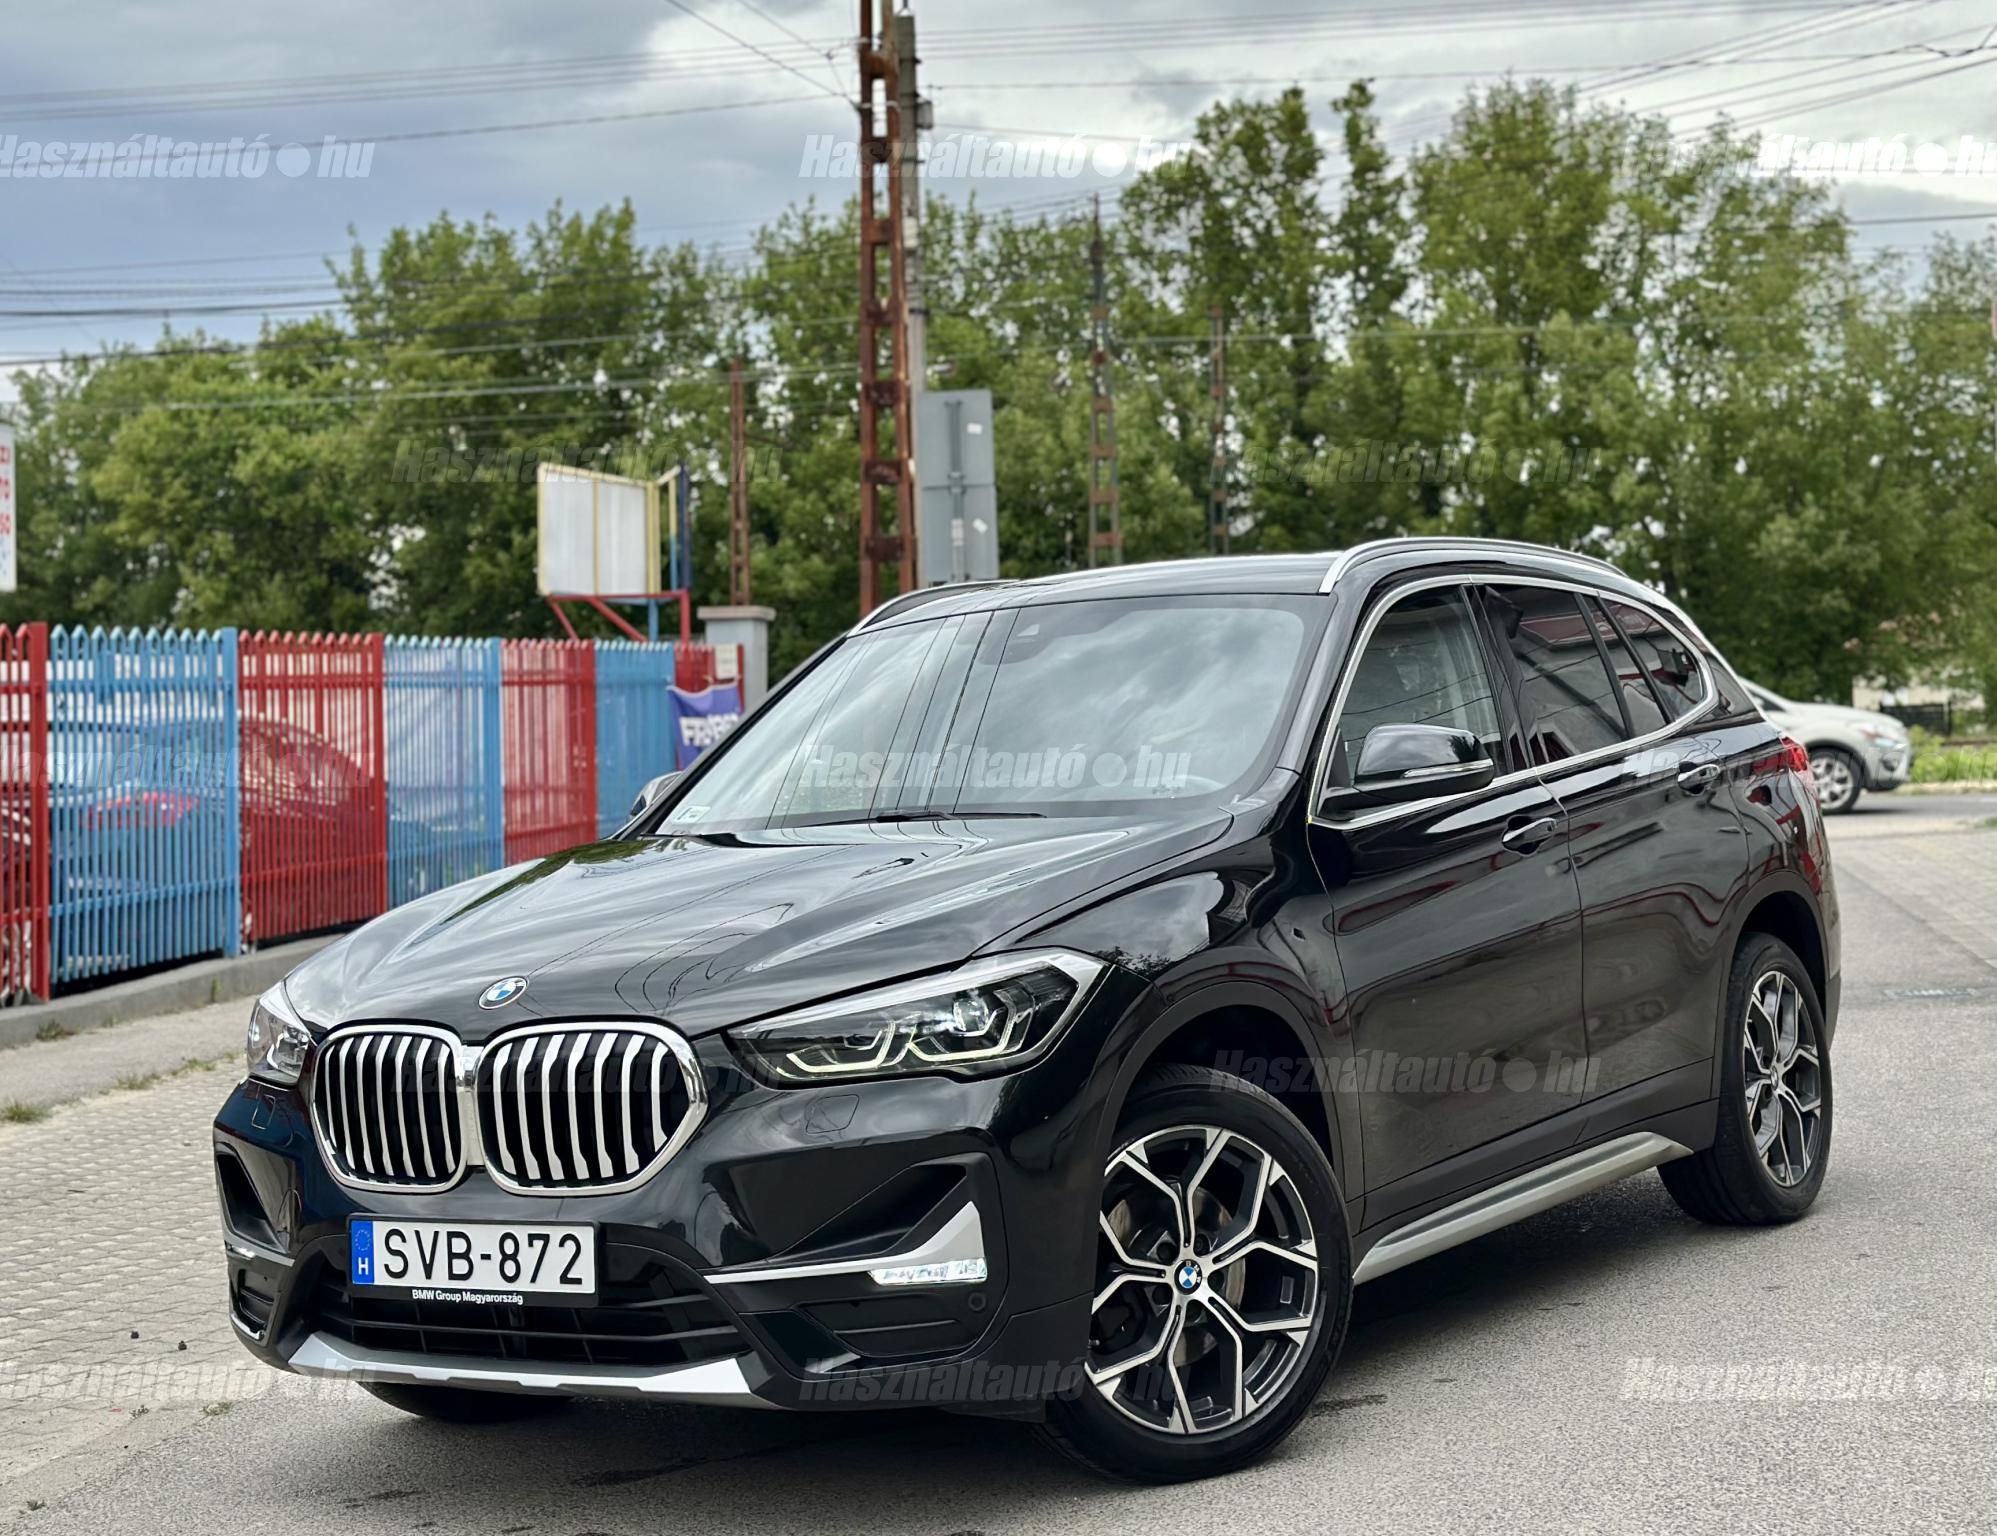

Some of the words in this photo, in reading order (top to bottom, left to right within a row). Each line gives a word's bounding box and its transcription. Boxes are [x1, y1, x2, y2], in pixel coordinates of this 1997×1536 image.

[383, 1228, 583, 1285] SVB-872
[358, 1257, 369, 1275] H
[411, 1289, 434, 1300] BMW
[435, 1290, 461, 1303] Group
[462, 1291, 524, 1305] Magyarország
